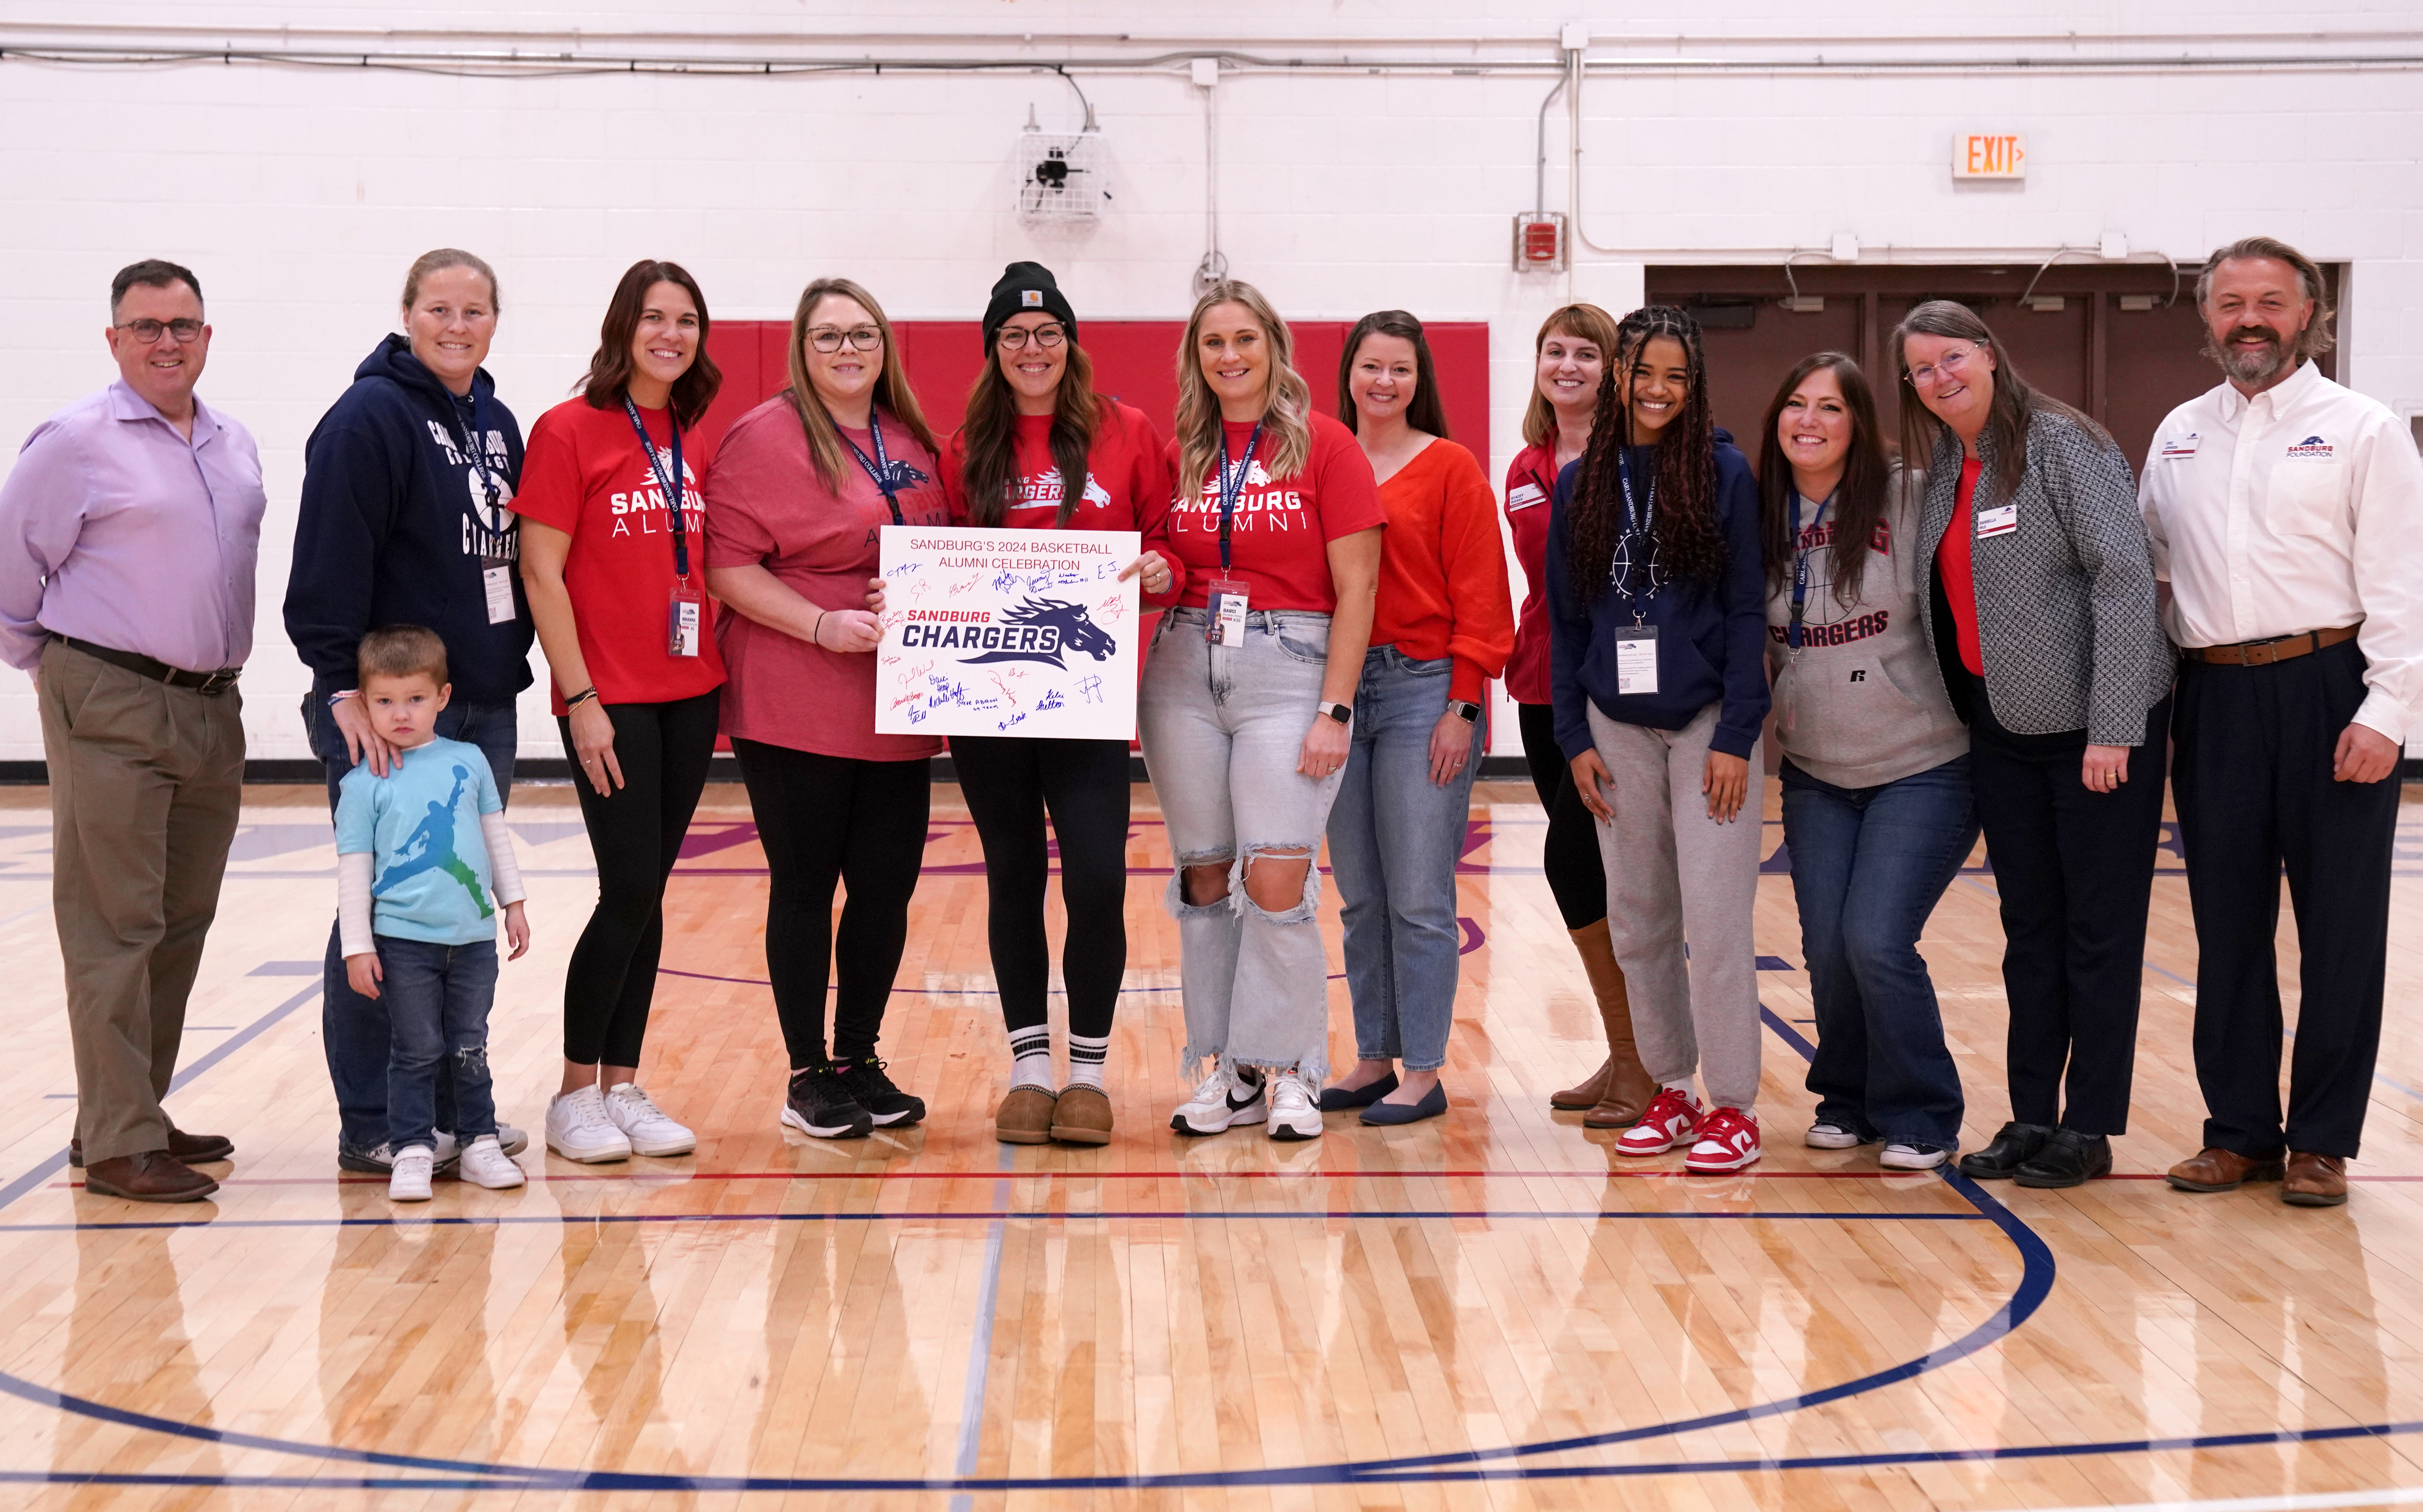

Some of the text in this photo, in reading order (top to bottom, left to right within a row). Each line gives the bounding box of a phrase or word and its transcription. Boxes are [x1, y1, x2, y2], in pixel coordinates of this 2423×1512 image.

[1968, 136, 2017, 173] EXIT
[645, 441, 659, 468] COLLEGE
[1247, 441, 1255, 455] CARL
[657, 467, 673, 497] SANDBURG
[864, 460, 883, 484] COLLEGE
[1236, 455, 1250, 483] SANDBURG
[1625, 492, 1637, 523] SANDBURG
[1644, 501, 1653, 532] SANDBURG
[612, 512, 705, 538] ALUM
[1168, 512, 1306, 533] LUMNI
[910, 539, 1112, 555] SANDBURG'S 2024 BASKETBALL
[939, 558, 1080, 570] ALUMNI CELEBRATION
[907, 610, 990, 623] SANDBURG
[1767, 610, 1889, 647] CHARGERS
[902, 625, 1059, 652] CHARGERS
